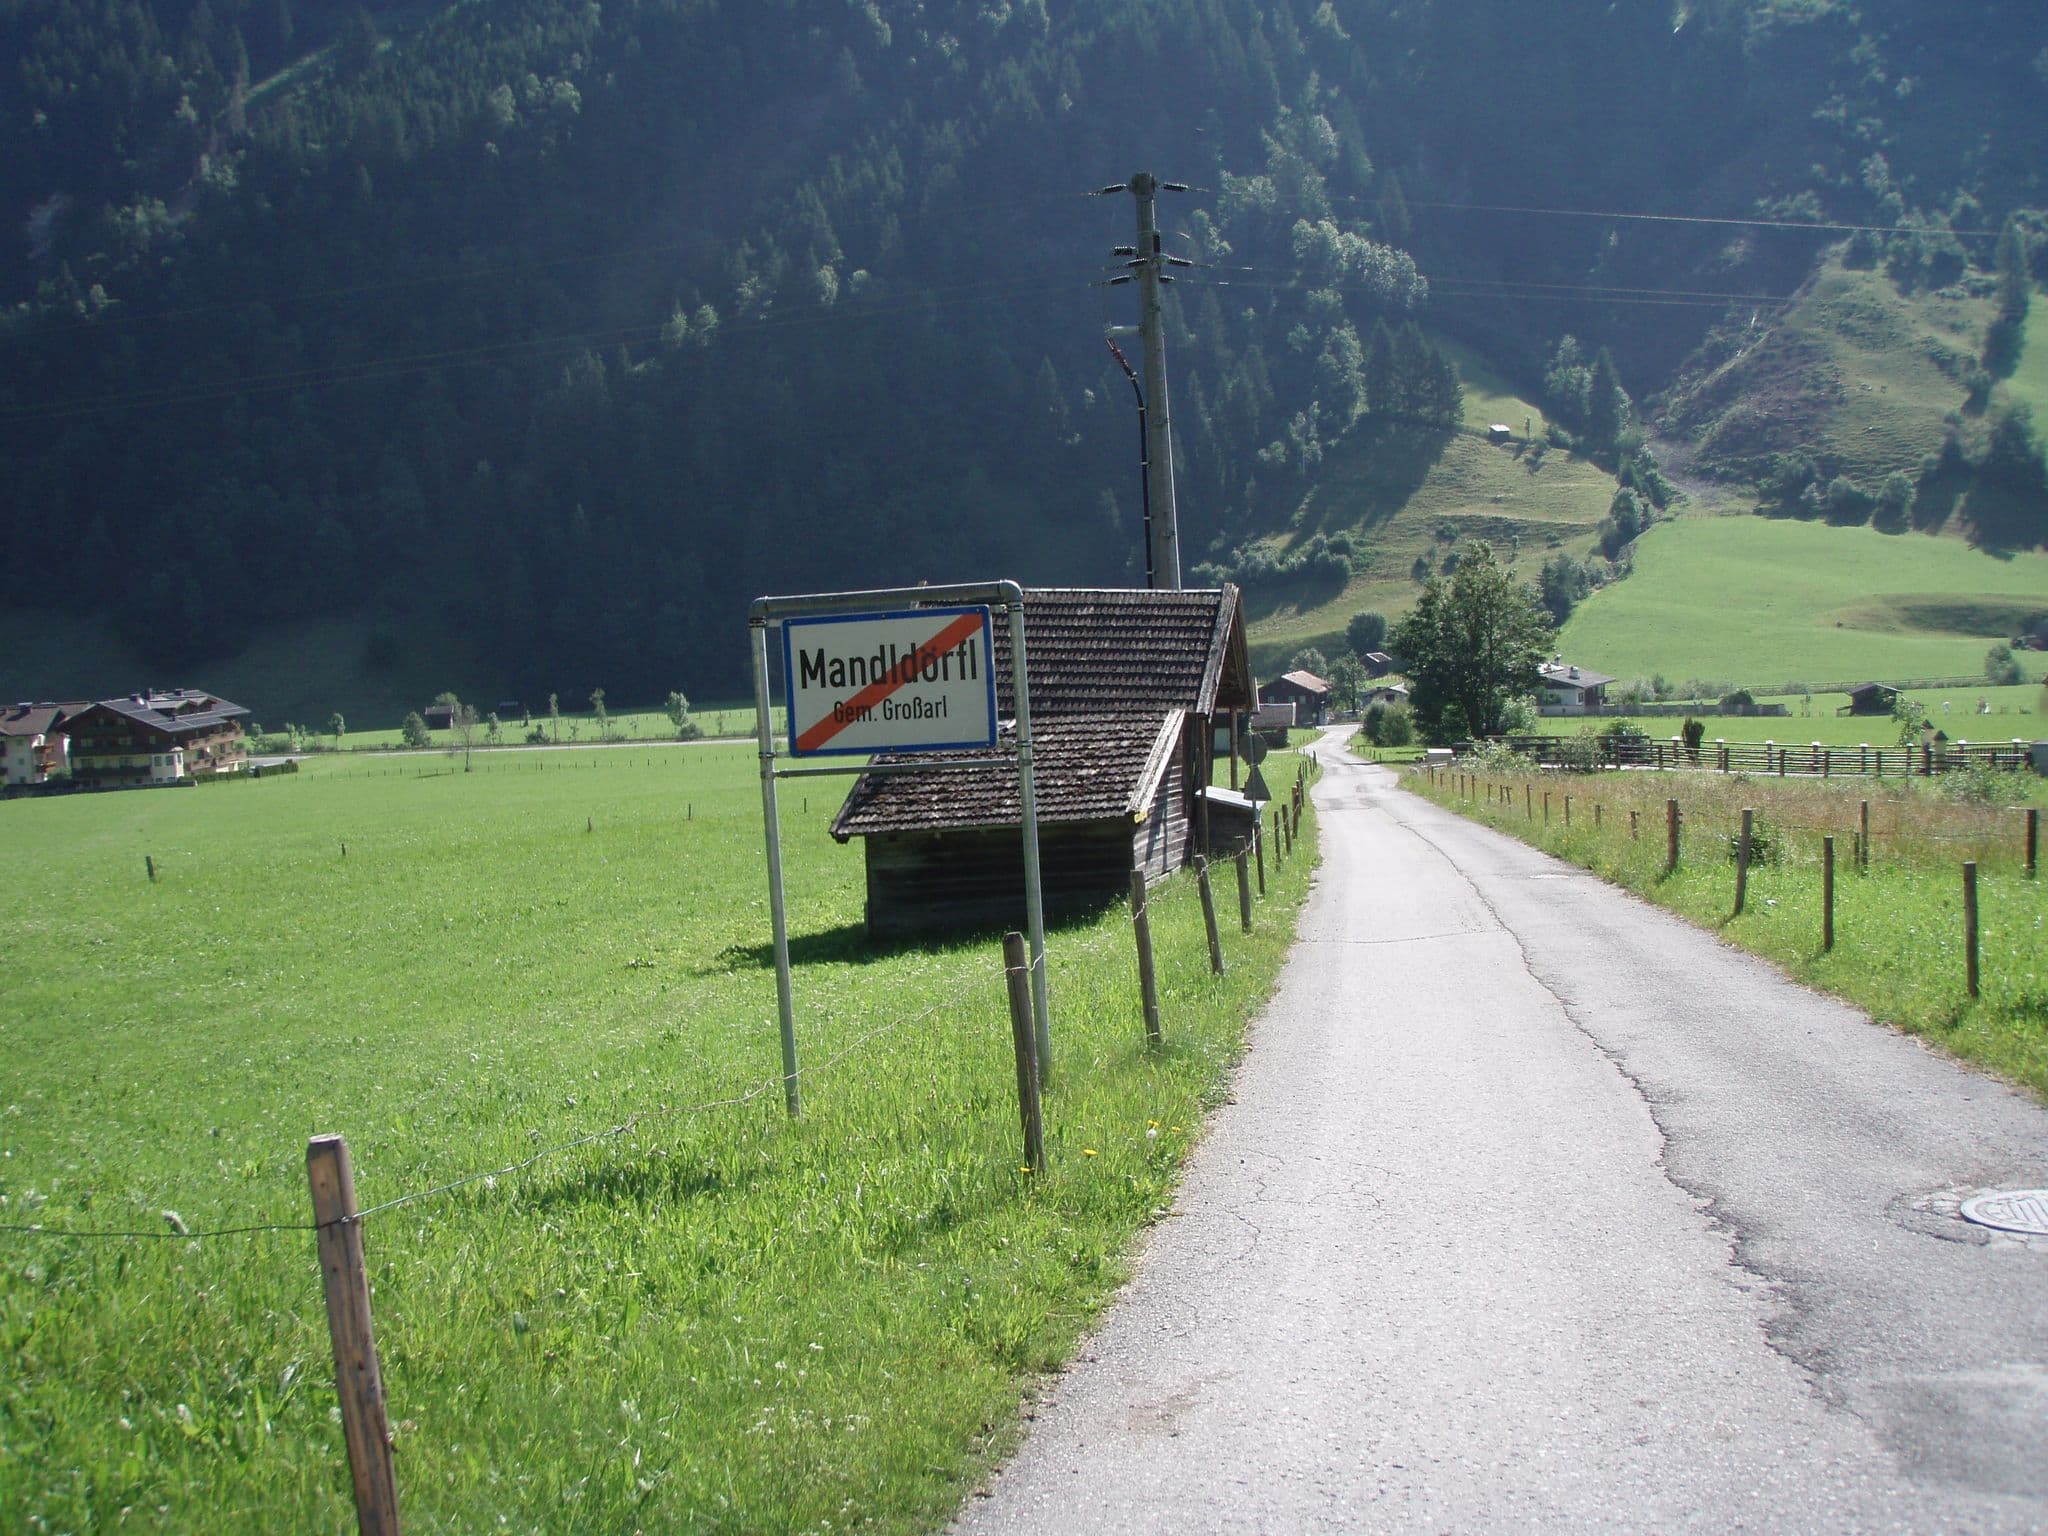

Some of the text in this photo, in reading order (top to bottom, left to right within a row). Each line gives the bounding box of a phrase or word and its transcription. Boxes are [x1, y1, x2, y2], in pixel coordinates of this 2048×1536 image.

[800, 639, 977, 689] Mandldörfl
[834, 695, 947, 723] Gem. Großarl
